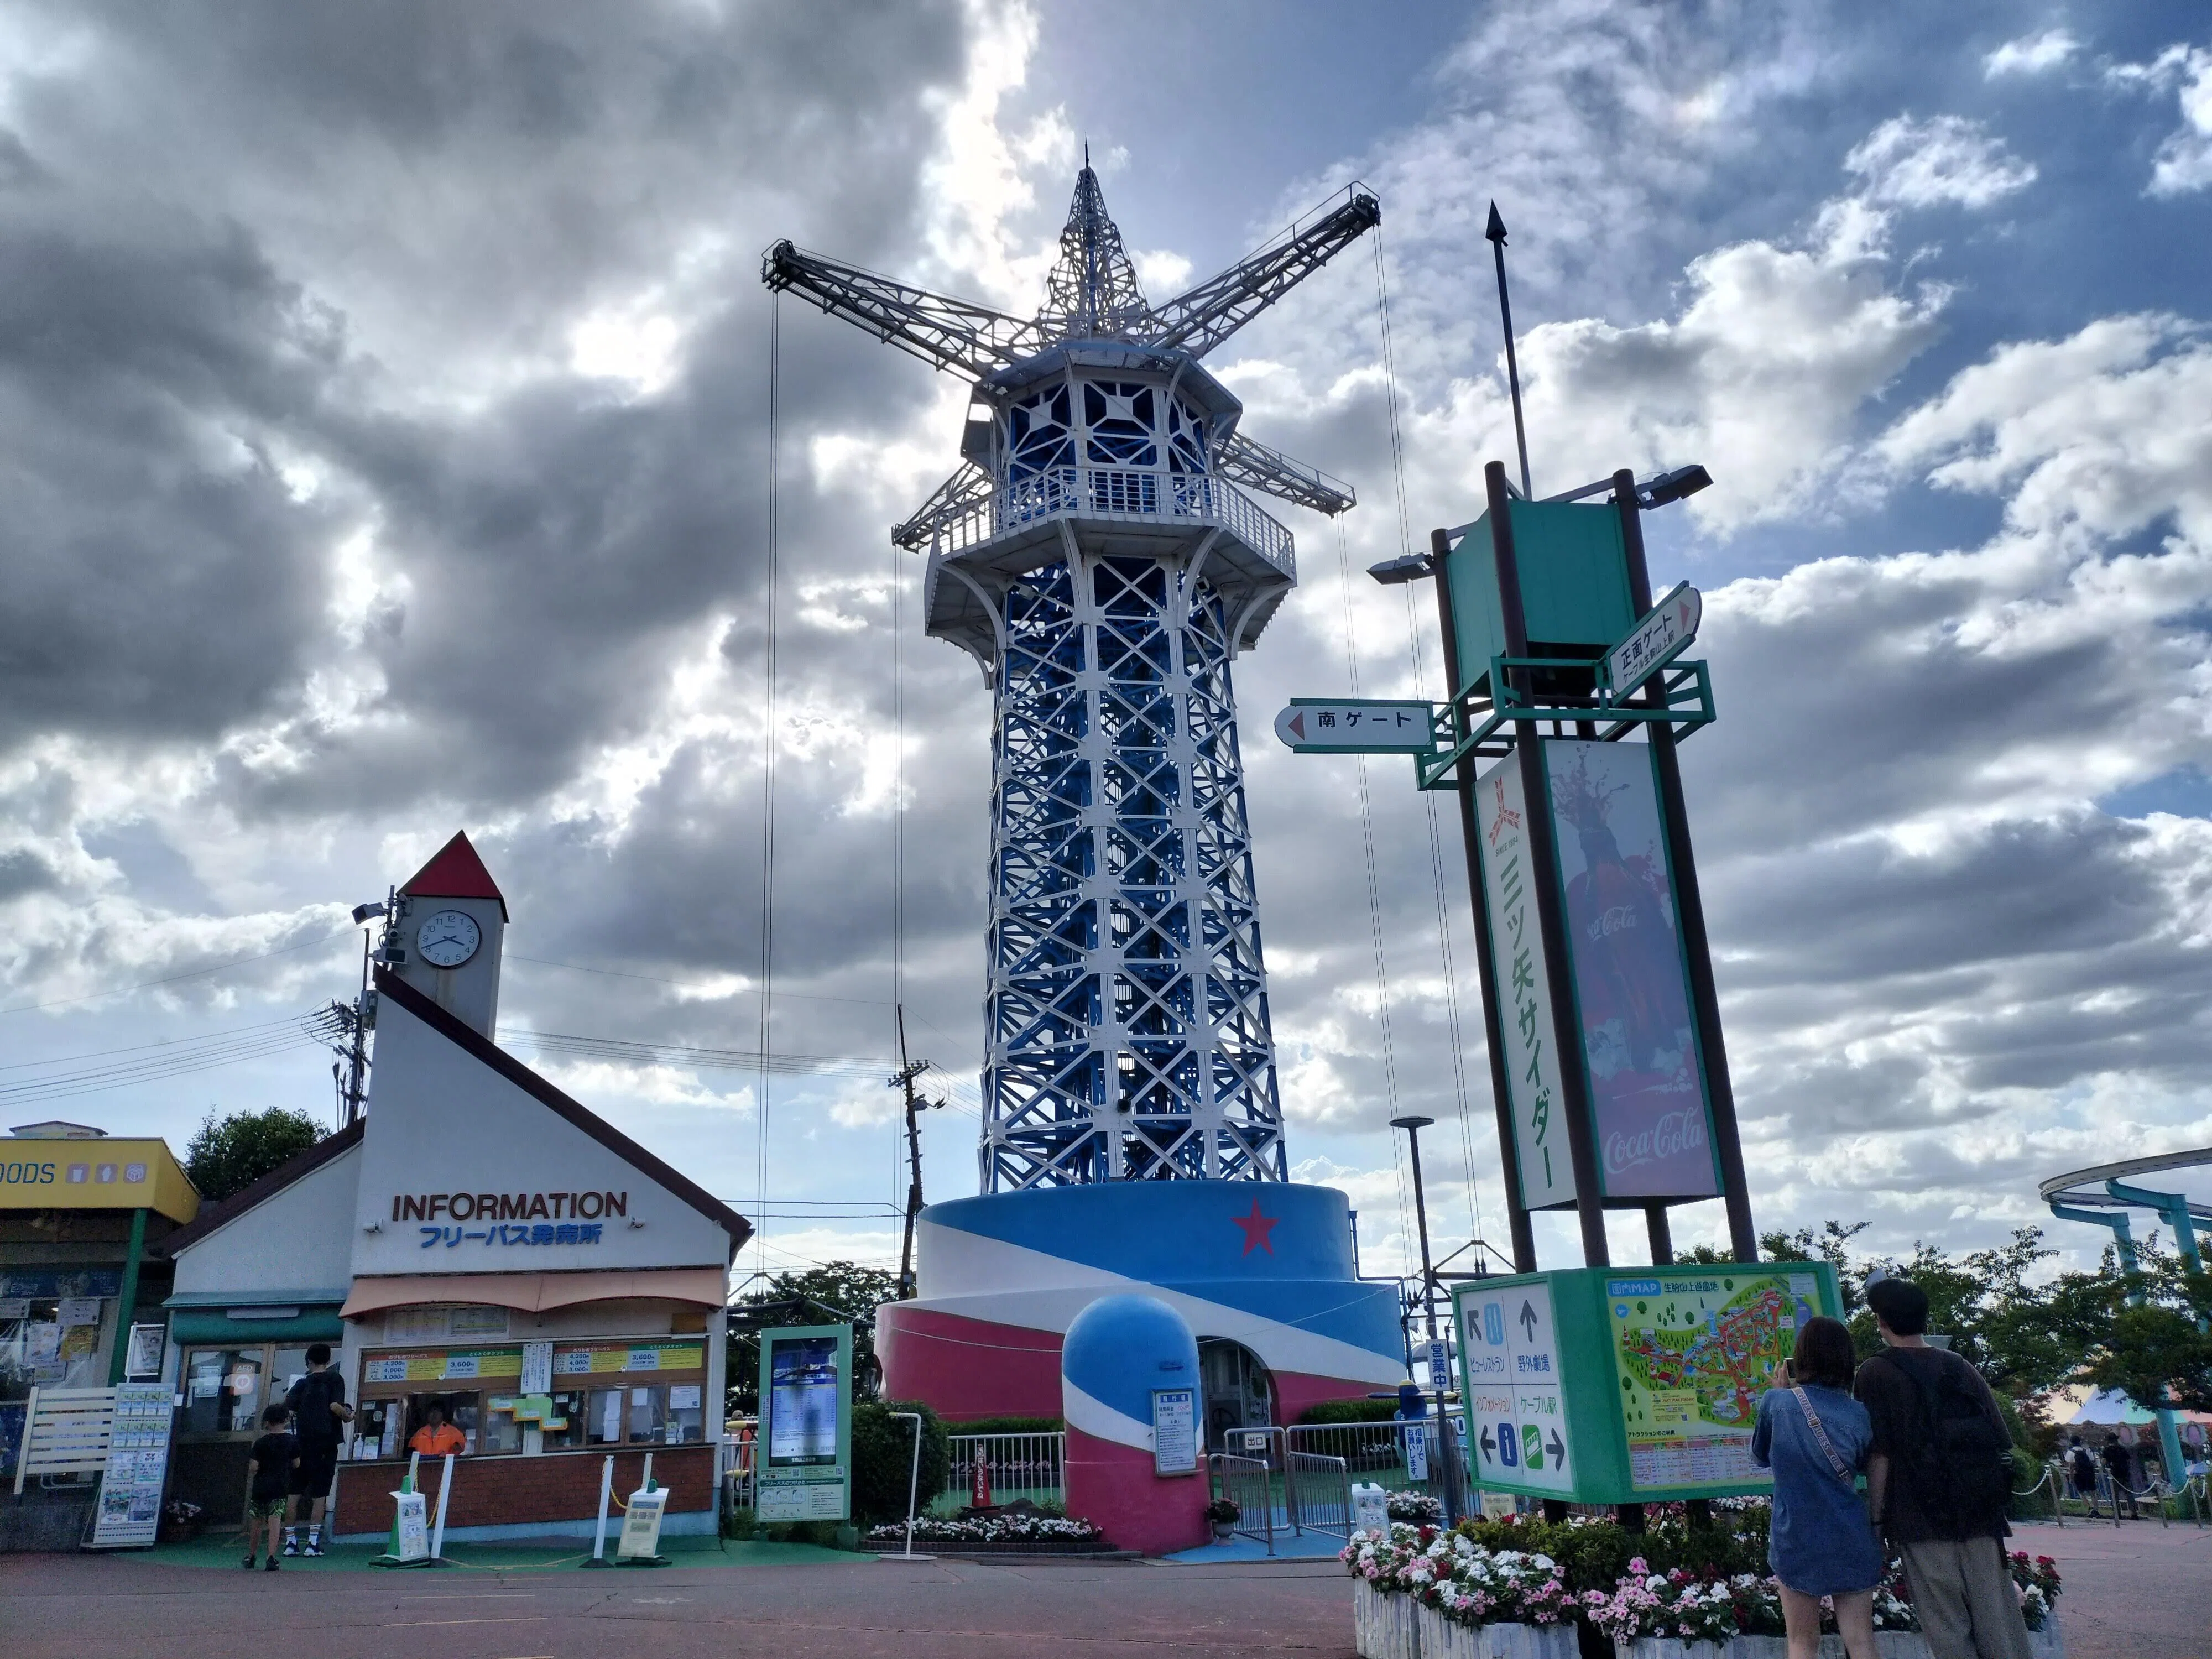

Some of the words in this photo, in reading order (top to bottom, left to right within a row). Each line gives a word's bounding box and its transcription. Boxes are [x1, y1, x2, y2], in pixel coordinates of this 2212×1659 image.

[1621, 614, 1672, 671] 正面ゲート
[1317, 711, 1411, 728] 南ゲート
[1500, 853, 1552, 1189] 三ツ矢サイダー
[1604, 1105, 1704, 1175] Coca-Cola
[392, 1191, 627, 1222] INFORMATION
[420, 1223, 603, 1248] フリーパス発売所
[1611, 1282, 1657, 1295] 園内MAP
[1663, 1281, 1719, 1292] 生駒山上遊園地
[1430, 1343, 1447, 1388] 営業中
[1470, 1356, 1505, 1373] ビューレストラン
[1517, 1354, 1550, 1373] 野外劇場
[1476, 1396, 1511, 1412] インフォメーション
[1520, 1395, 1558, 1415] ケーブル駅
[1798, 1392, 1815, 1420] GUESS
[1814, 1425, 1831, 1451] UESS
[1248, 1436, 1264, 1446] 出口
[1407, 1428, 1418, 1479] お願いします。
